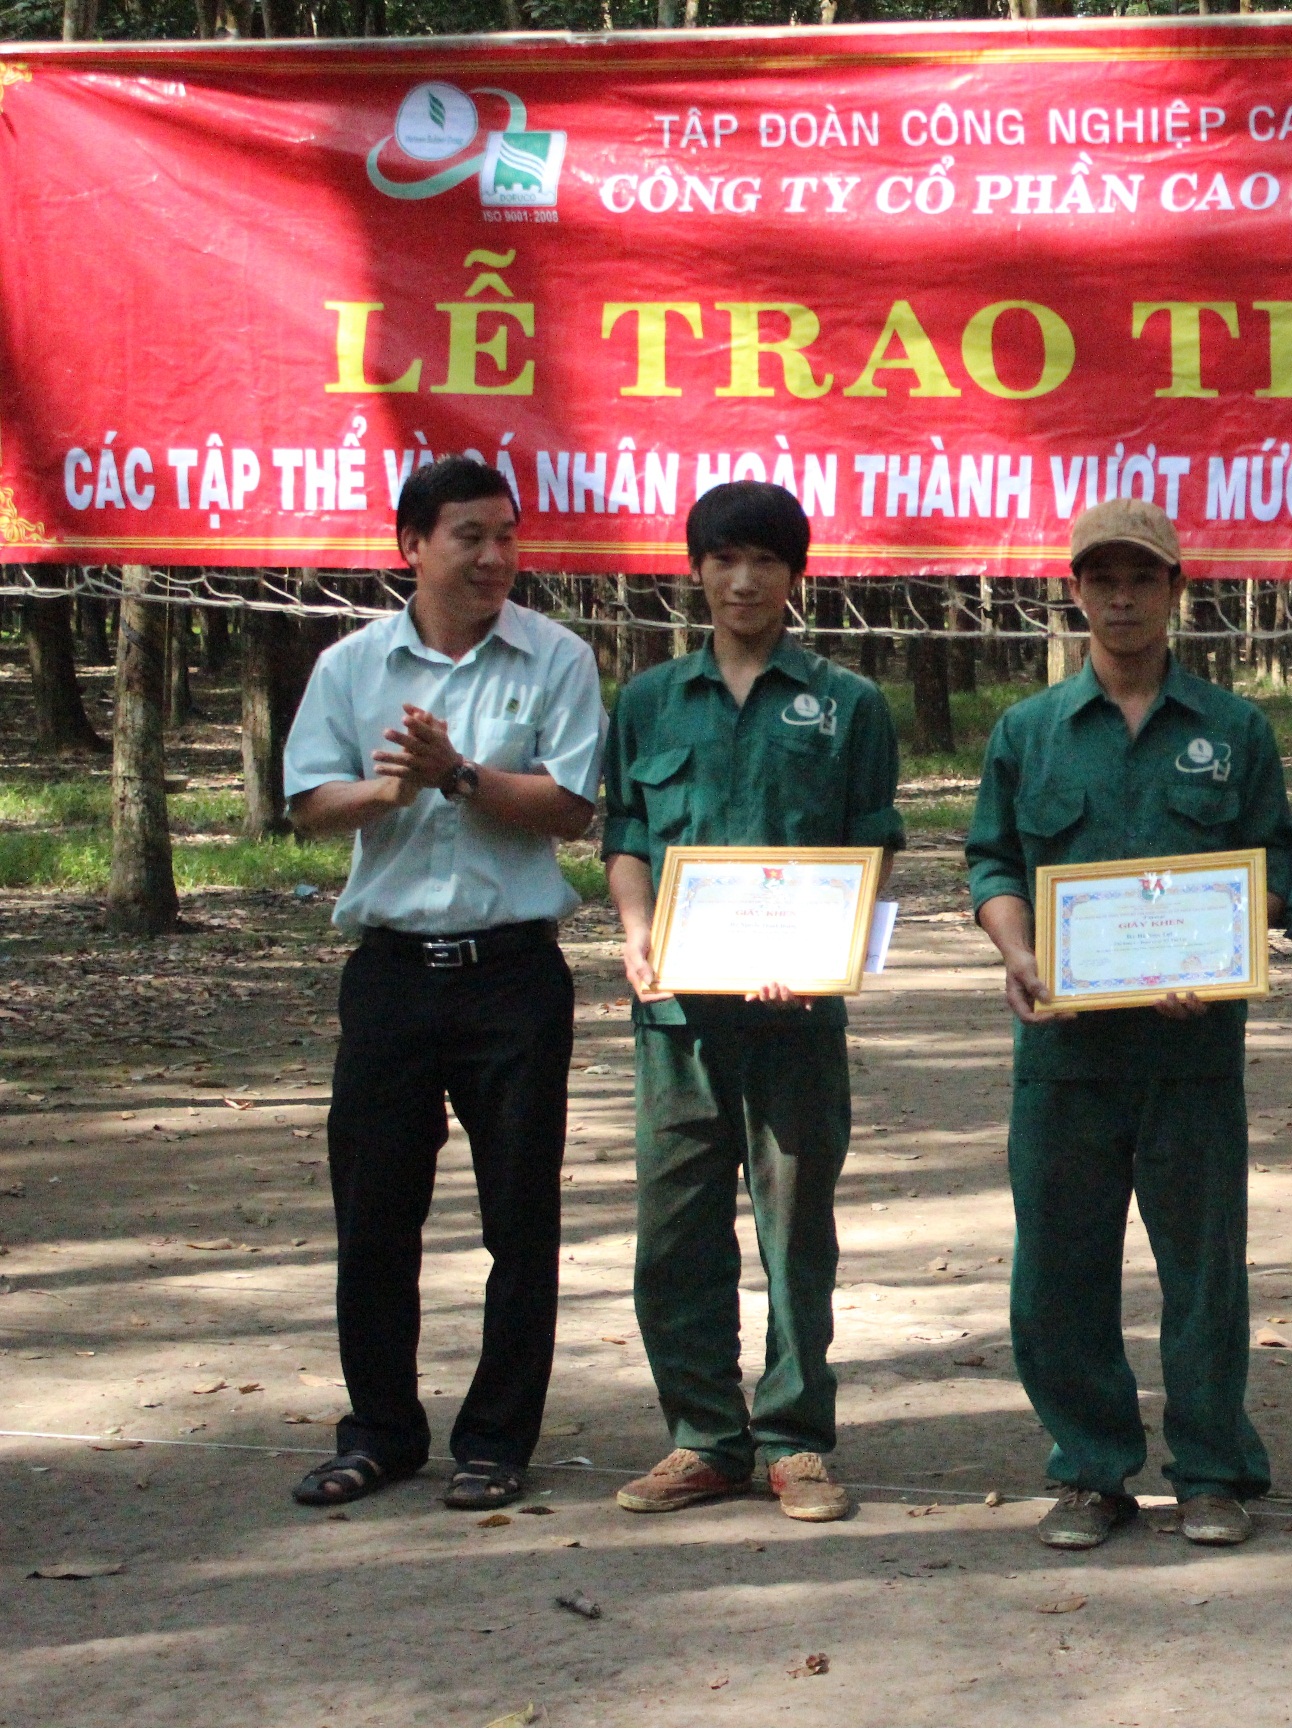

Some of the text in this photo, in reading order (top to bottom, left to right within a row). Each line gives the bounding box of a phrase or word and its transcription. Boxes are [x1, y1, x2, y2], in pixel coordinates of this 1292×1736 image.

[653, 107, 740, 153] TẬP
[758, 104, 880, 148] ĐOÀN
[901, 102, 1026, 147] CÔNG
[1046, 99, 1226, 148] NGHIỆP
[603, 173, 762, 215] CÔNG
[781, 172, 861, 214] TY
[874, 154, 957, 216] CỔ
[972, 151, 1145, 215] PHẦN
[1159, 172, 1281, 213] CAO
[483, 211, 502, 222] ISO
[323, 249, 536, 396] LỄ
[601, 300, 1076, 399] TRAO
[63, 431, 156, 511] CÁC
[169, 433, 262, 530] TẬP
[272, 415, 368, 512] THỂ
[537, 436, 682, 517] NHÂN
[854, 435, 1033, 520] THÀNH
[1050, 441, 1190, 520] VƯỢT
